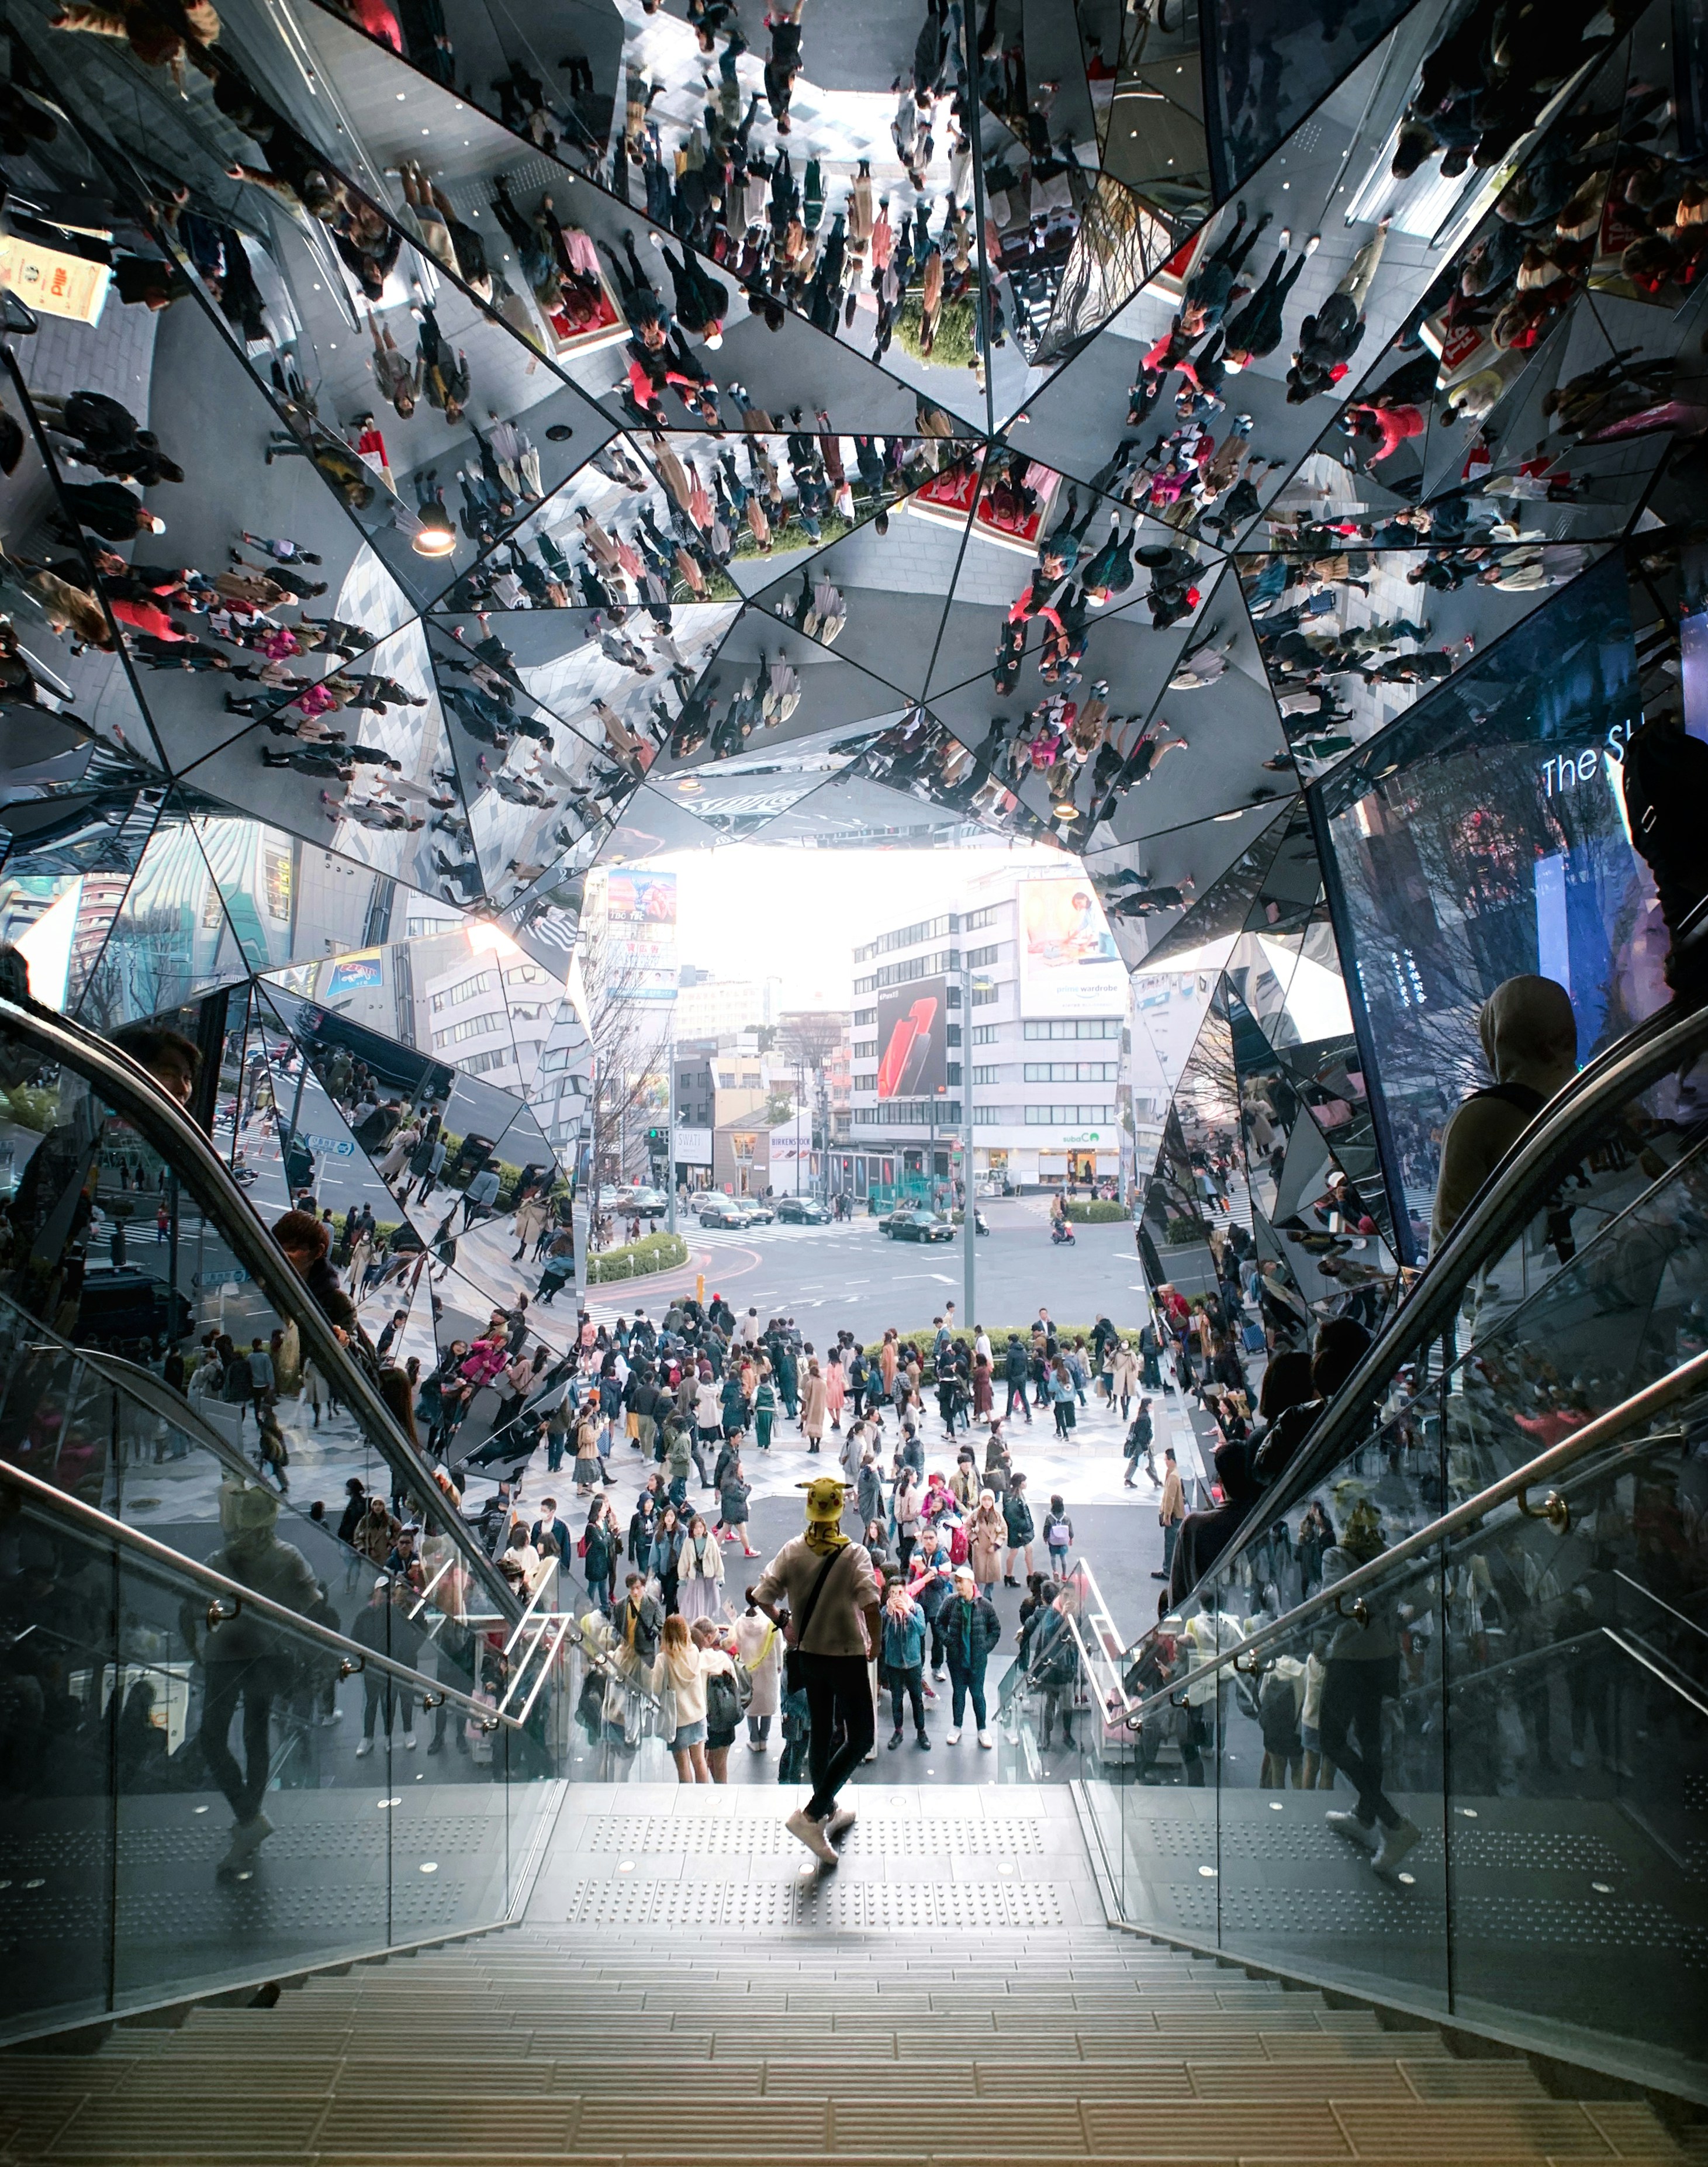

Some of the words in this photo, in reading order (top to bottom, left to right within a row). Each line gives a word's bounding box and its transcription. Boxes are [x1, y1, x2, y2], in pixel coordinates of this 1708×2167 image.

[1543, 749, 1597, 798] The
[1056, 985, 1079, 994] prime
[1080, 984, 1118, 992] wardrobe
